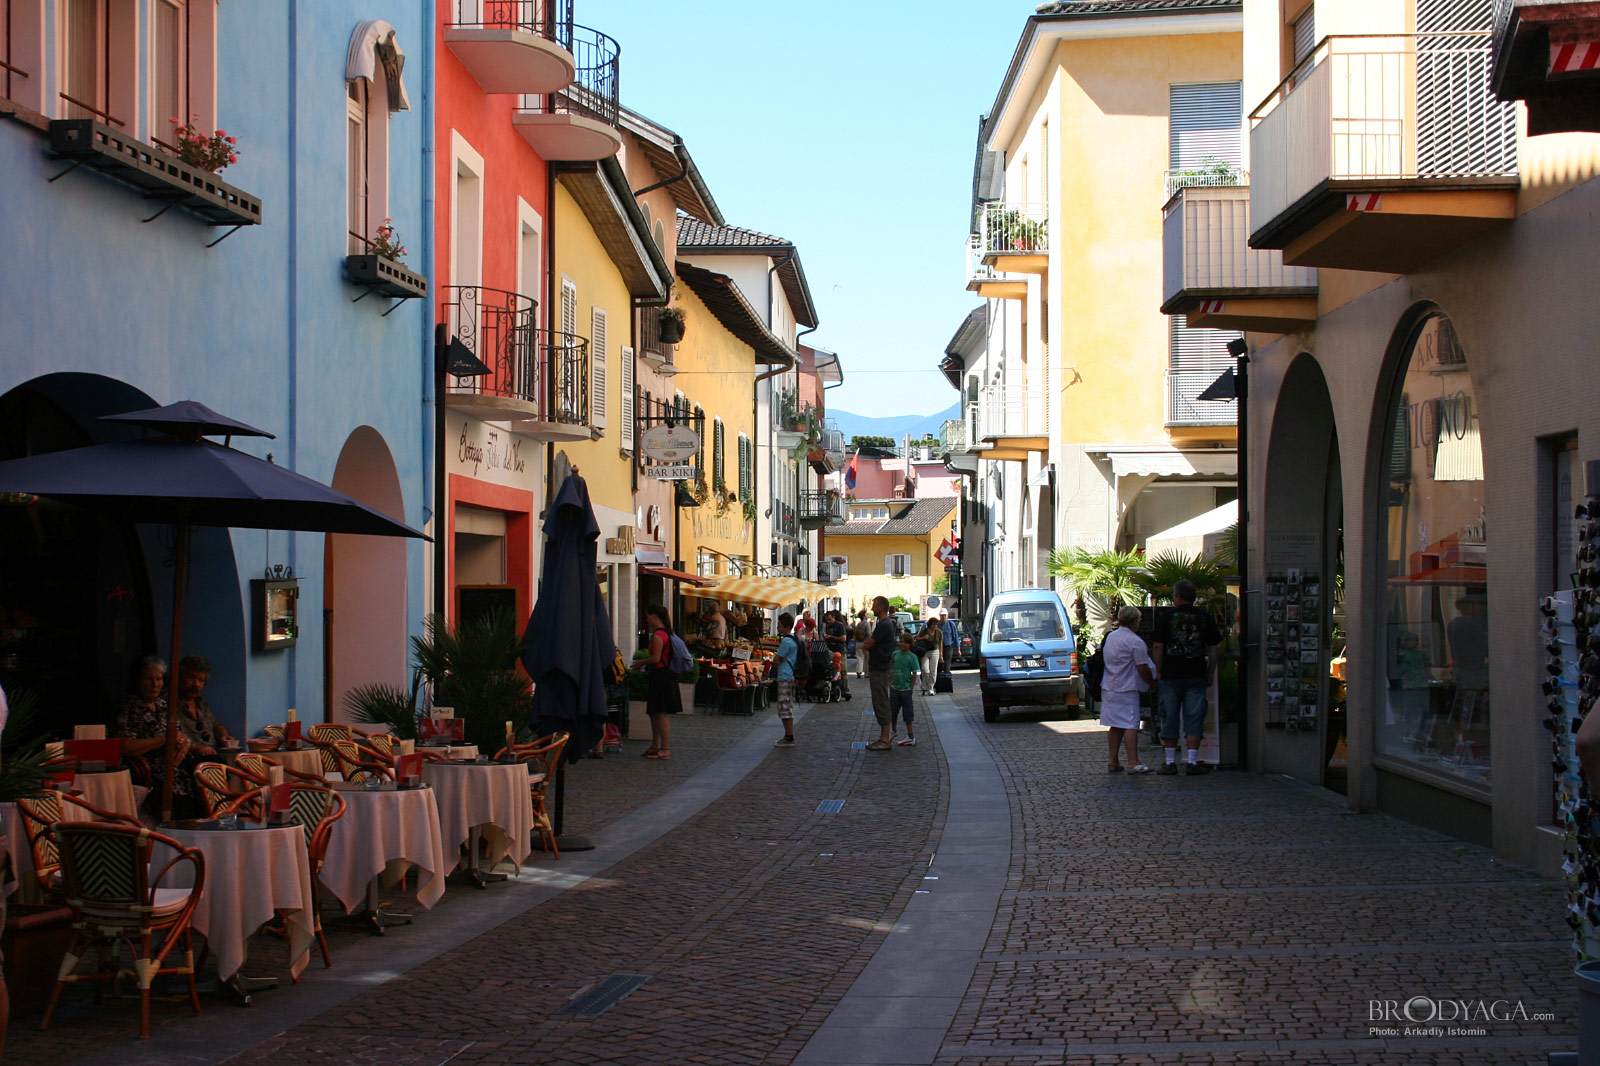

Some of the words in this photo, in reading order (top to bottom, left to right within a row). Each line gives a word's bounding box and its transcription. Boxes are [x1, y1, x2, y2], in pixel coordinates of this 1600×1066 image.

[1403, 391, 1467, 452] TICINO
[647, 468, 668, 477] BAR
[672, 468, 693, 477] KIKI
